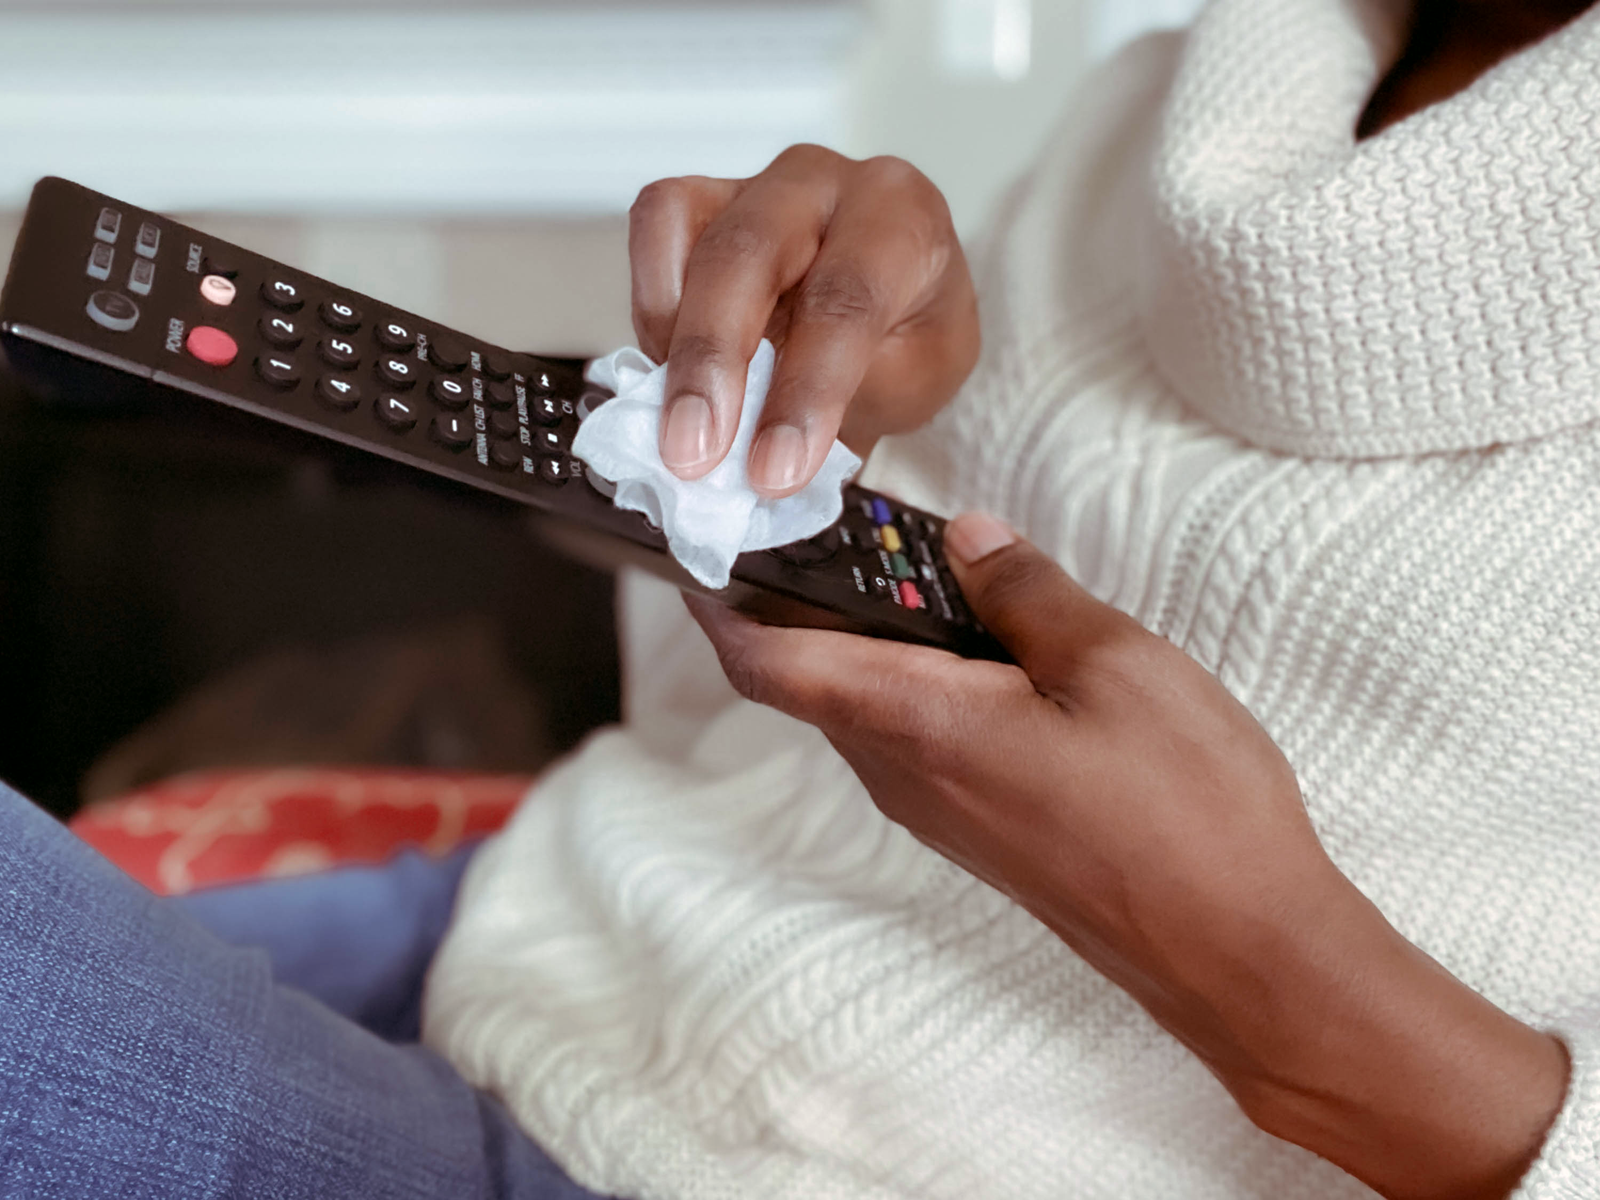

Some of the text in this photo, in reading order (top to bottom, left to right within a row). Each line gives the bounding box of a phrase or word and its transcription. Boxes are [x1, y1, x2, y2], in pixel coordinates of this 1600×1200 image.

[186, 243, 202, 273] SOURCE
[274, 281, 296, 296] 3
[332, 303, 353, 316] 6
[273, 318, 294, 333] 2
[388, 324, 408, 337] 9
[165, 317, 185, 353] POWER
[331, 340, 353, 354] 5
[416, 333, 427, 361] PRE-CH
[270, 358, 291, 370] 1
[388, 361, 409, 374] 8
[471, 351, 482, 371] HDMI
[330, 379, 351, 393] 4
[443, 381, 462, 393] 0
[390, 399, 411, 413] 7
[562, 400, 573, 414] CH
[519, 426, 531, 446] STOP
[476, 433, 488, 466] ANTENNA
[522, 455, 534, 474] REW
[570, 460, 582, 478] VOL
[852, 566, 866, 593] RETURN
